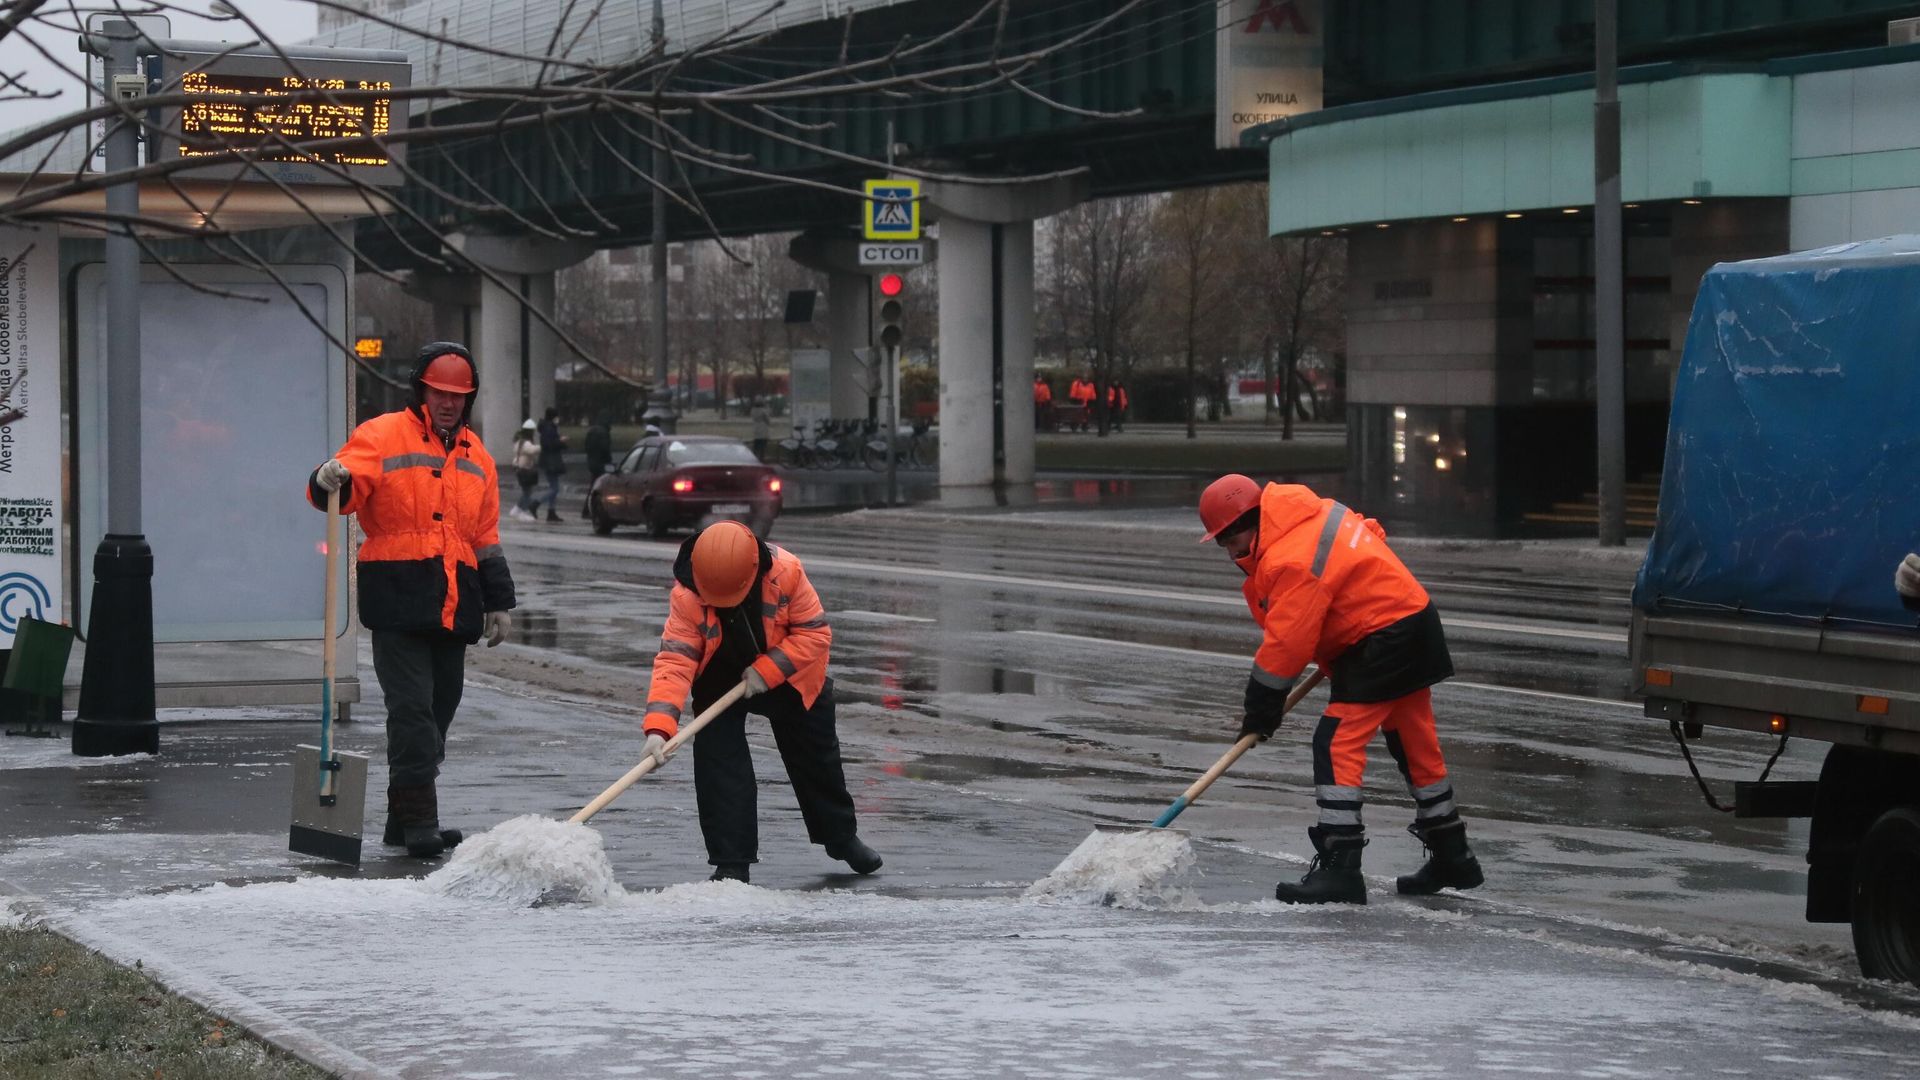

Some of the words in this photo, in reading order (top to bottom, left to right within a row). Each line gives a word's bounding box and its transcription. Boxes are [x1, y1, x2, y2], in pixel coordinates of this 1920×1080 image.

[1256, 93, 1298, 105] УЛИЦА
[1232, 112, 1289, 124] СКОБЕЛ
[864, 247, 919, 260] СТОП
[16, 254, 28, 341] Skobelevskay
[0, 425, 14, 473] Метро
[0, 507, 53, 518] РАБОТА
